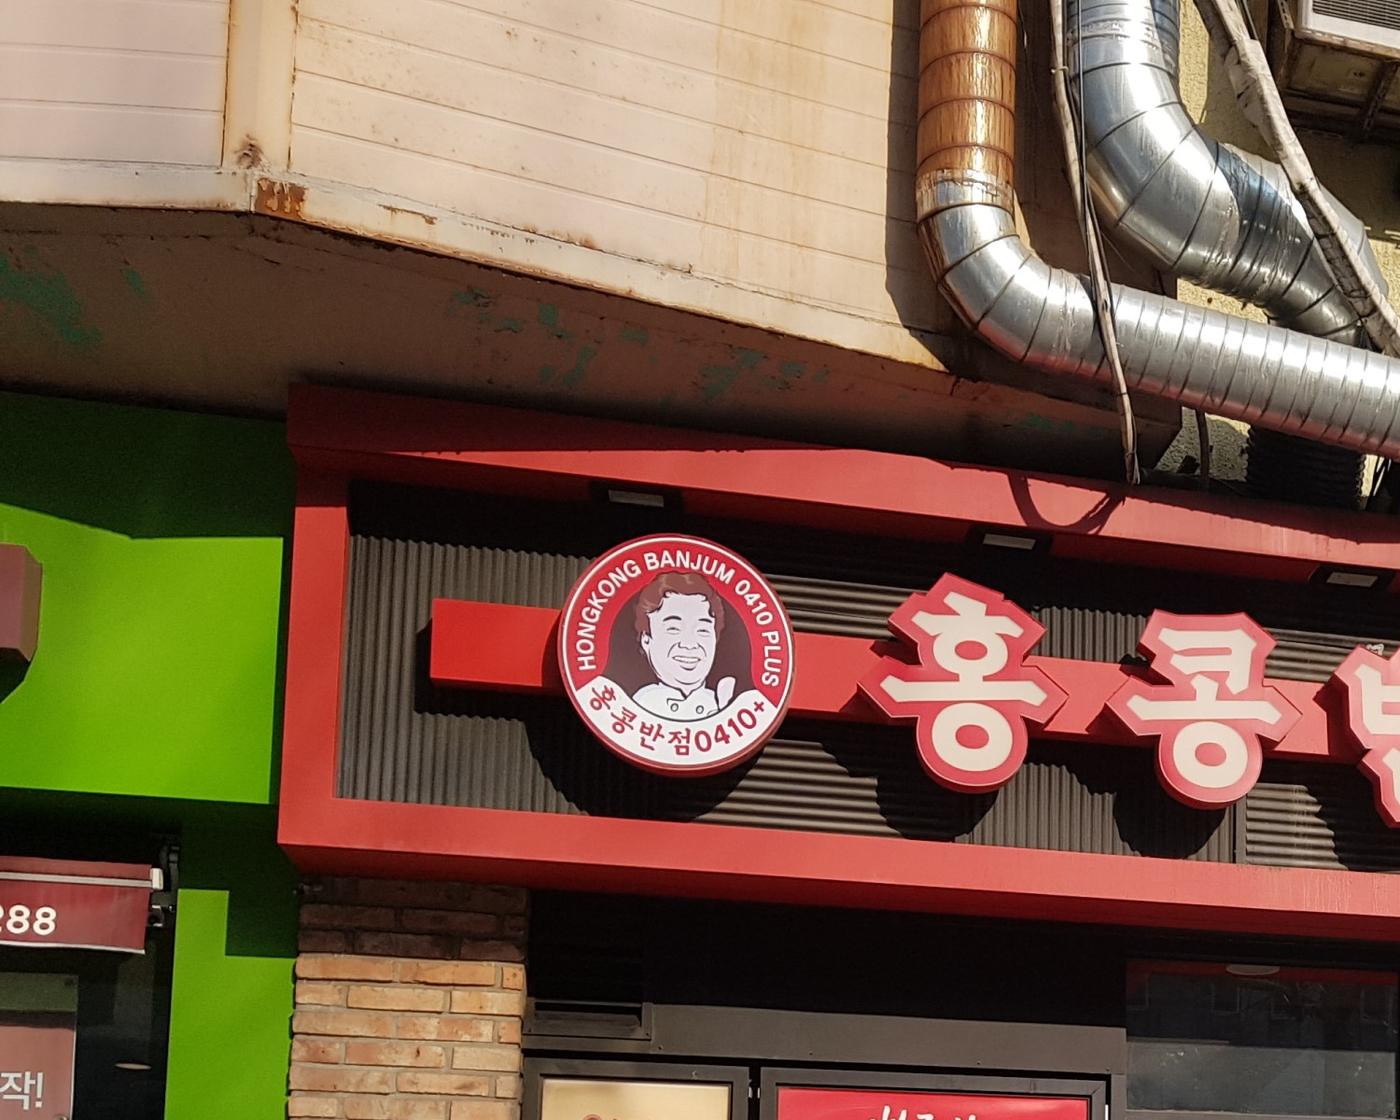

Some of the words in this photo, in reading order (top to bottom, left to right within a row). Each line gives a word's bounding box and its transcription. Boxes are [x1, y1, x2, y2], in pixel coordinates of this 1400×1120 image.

[576, 559, 641, 671] HONGKONG
[643, 550, 735, 584] BANJUM
[735, 579, 773, 625] 0410
[761, 630, 782, 687] PLUS
[0, 904, 57, 936] 88
